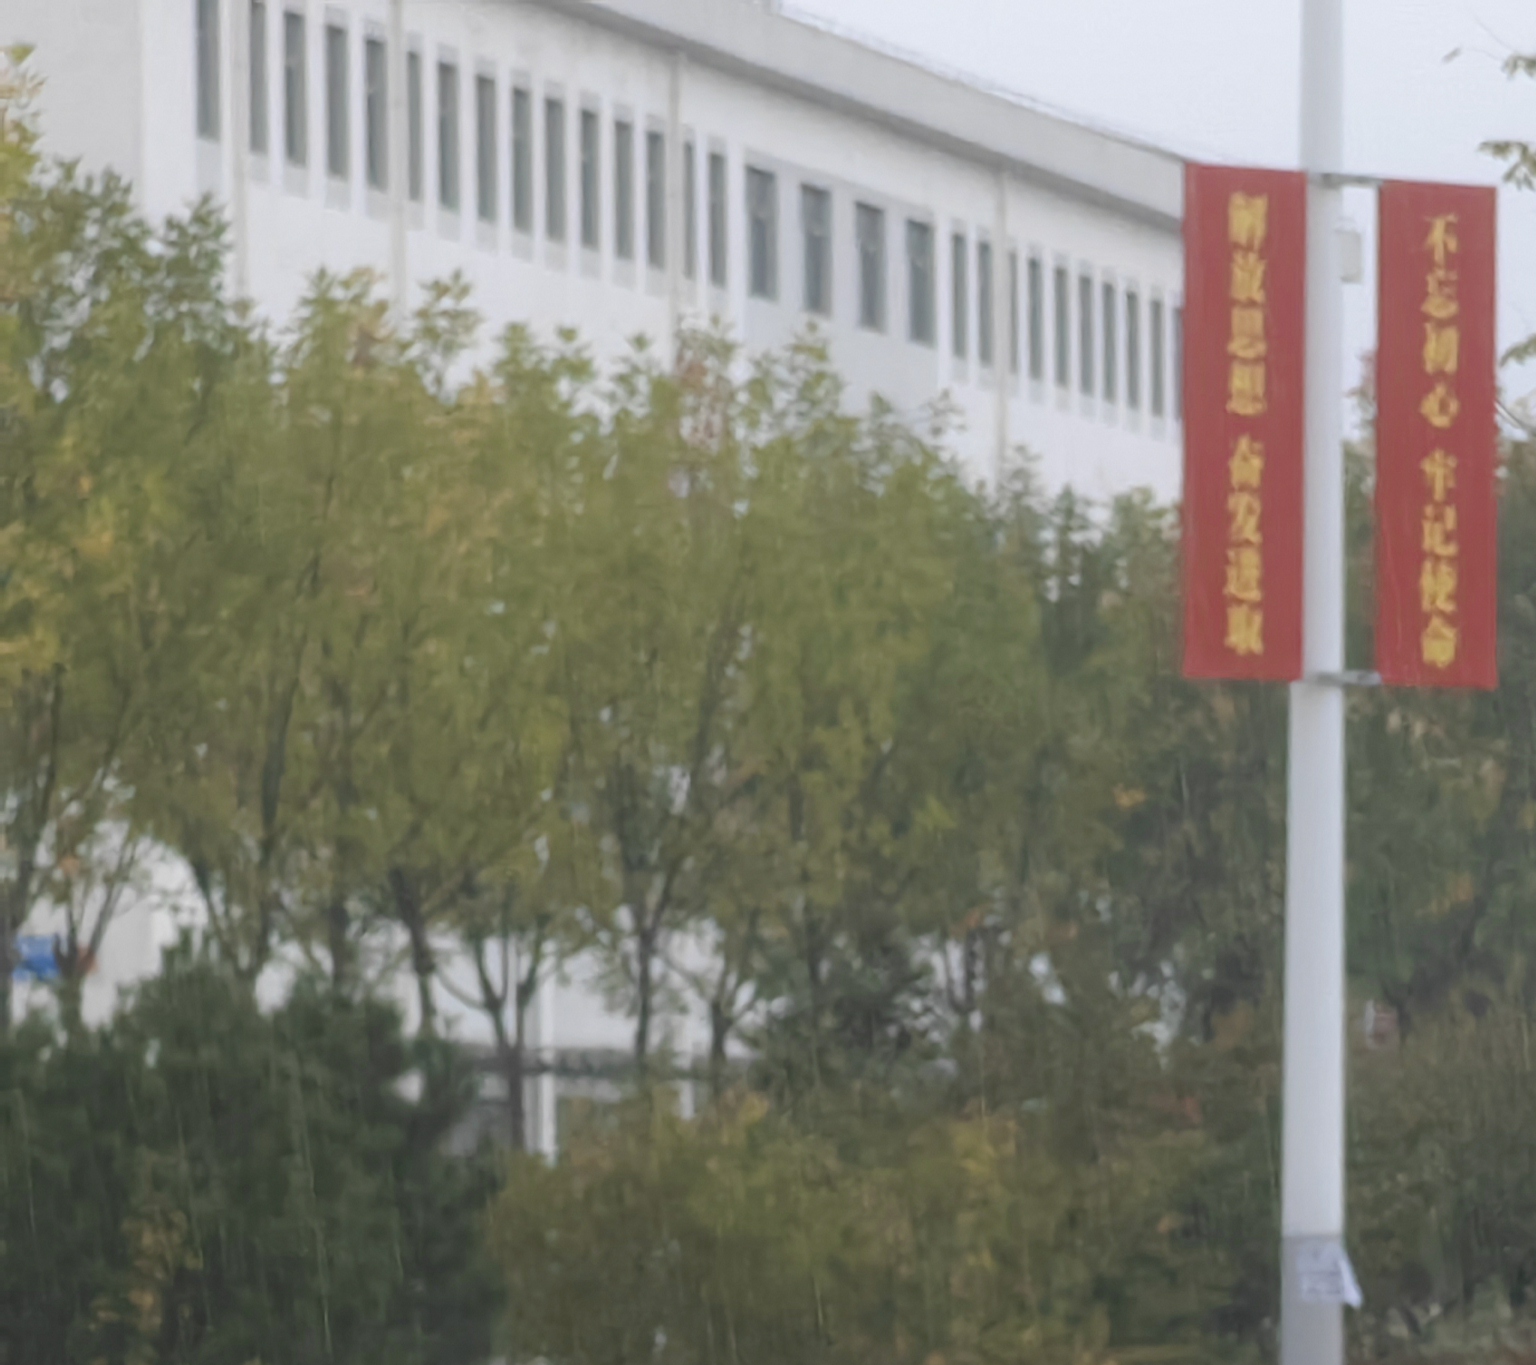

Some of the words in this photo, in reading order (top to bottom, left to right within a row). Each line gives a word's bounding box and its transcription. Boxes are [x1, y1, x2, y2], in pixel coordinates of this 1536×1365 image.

[1420, 214, 1460, 429] 不忘初心
[1420, 449, 1459, 669] 牢记使命
